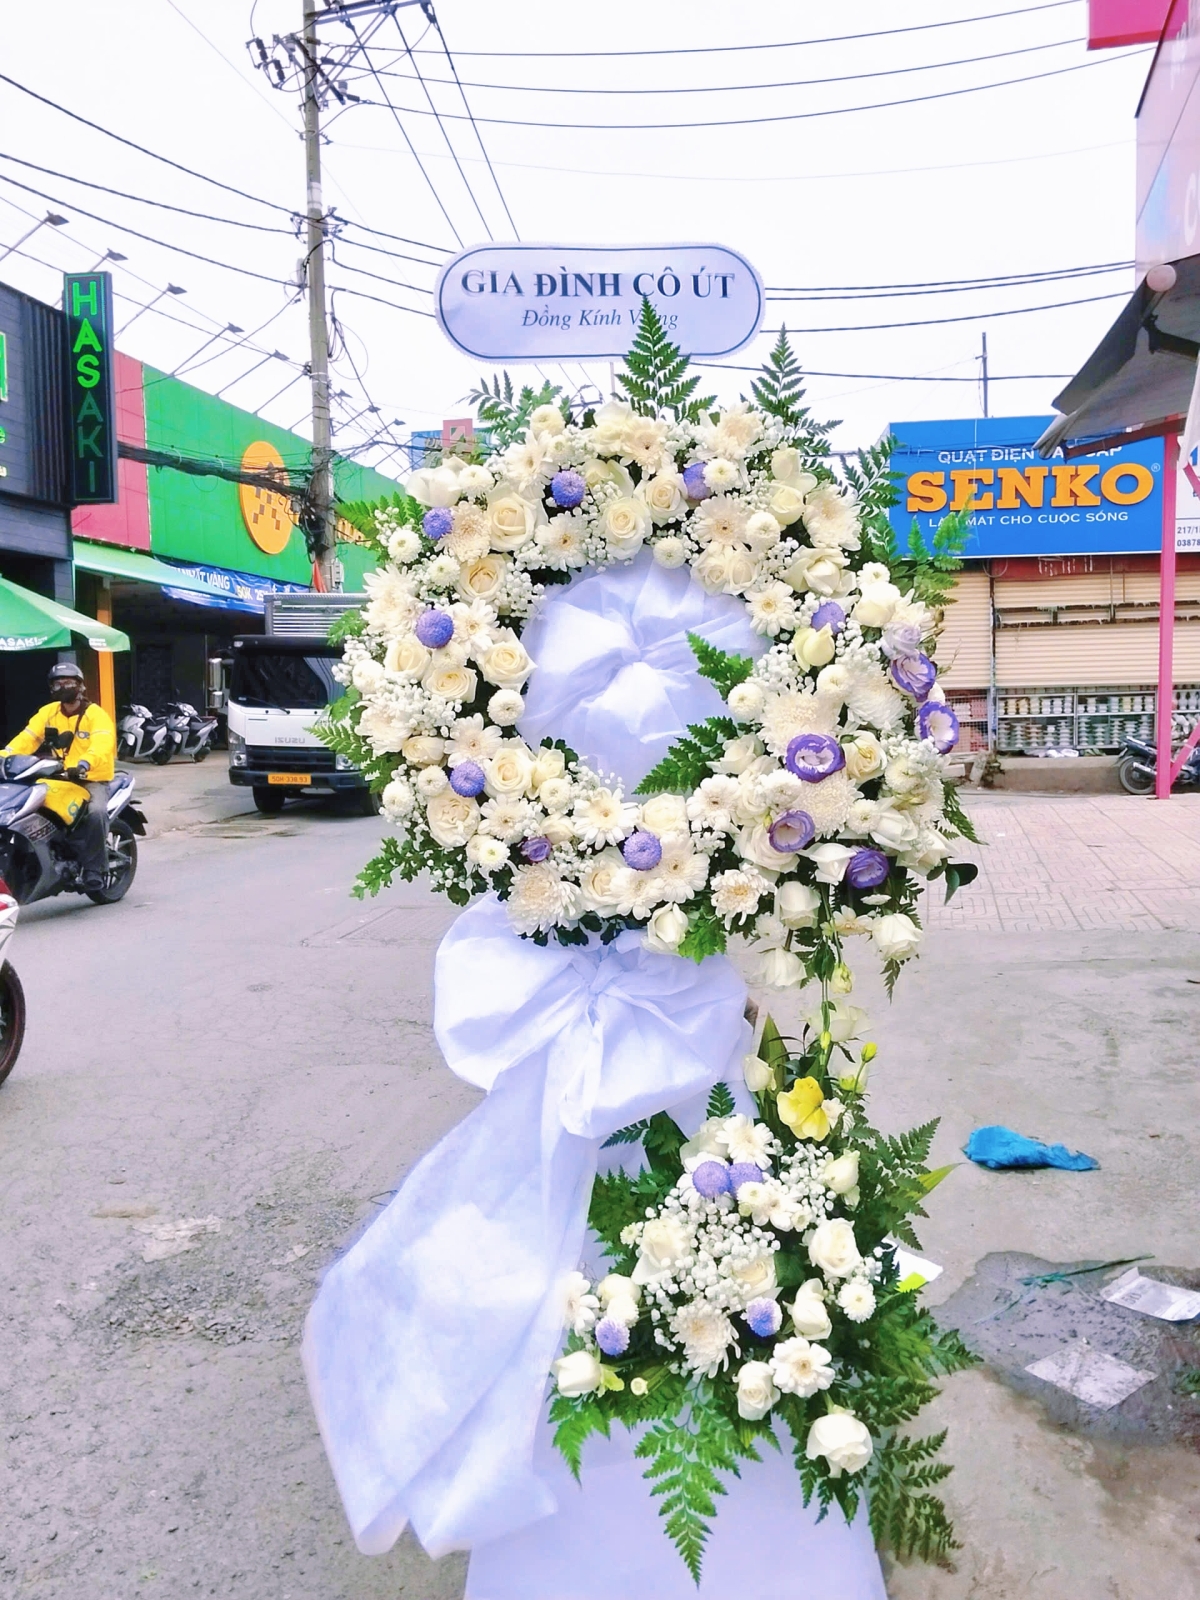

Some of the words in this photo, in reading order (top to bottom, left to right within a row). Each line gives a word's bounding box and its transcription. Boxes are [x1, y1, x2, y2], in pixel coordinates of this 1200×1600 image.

[461, 269, 525, 297] GIA
[533, 266, 622, 298] ĐÌNH
[632, 267, 681, 298] CÔ
[691, 265, 736, 299] ÚT
[521, 304, 571, 330] Đồng
[579, 309, 621, 326] Kính
[629, 304, 678, 331] Vng
[72, 280, 104, 493] HASAKI
[907, 462, 1154, 513] SENKO
[1000, 515, 1033, 525] CHO
[1037, 512, 1081, 525] CUỘC
[1085, 510, 1129, 522] SỐNG
